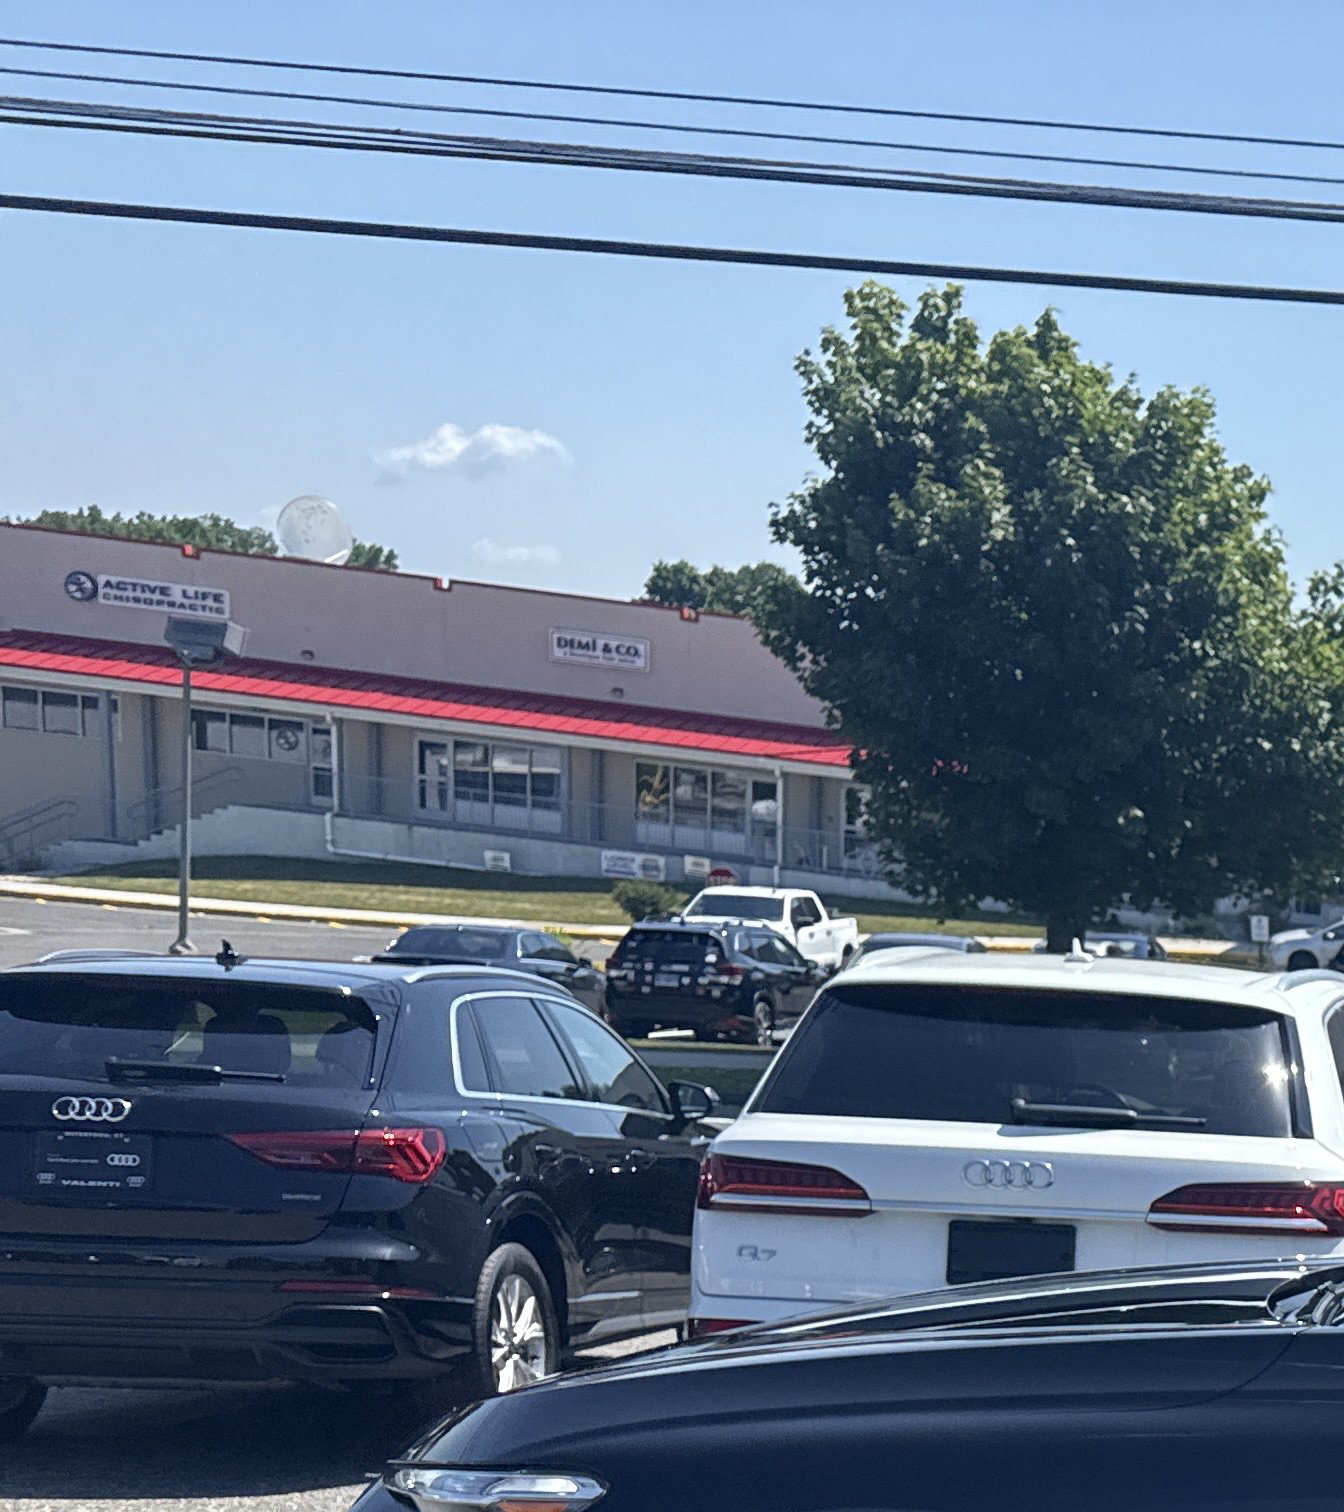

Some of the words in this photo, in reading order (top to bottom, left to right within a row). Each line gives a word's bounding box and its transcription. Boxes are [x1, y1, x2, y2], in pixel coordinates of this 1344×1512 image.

[103, 579, 172, 597] ACTIVE
[182, 589, 225, 604] LIFE
[738, 1246, 777, 1261] Q7
